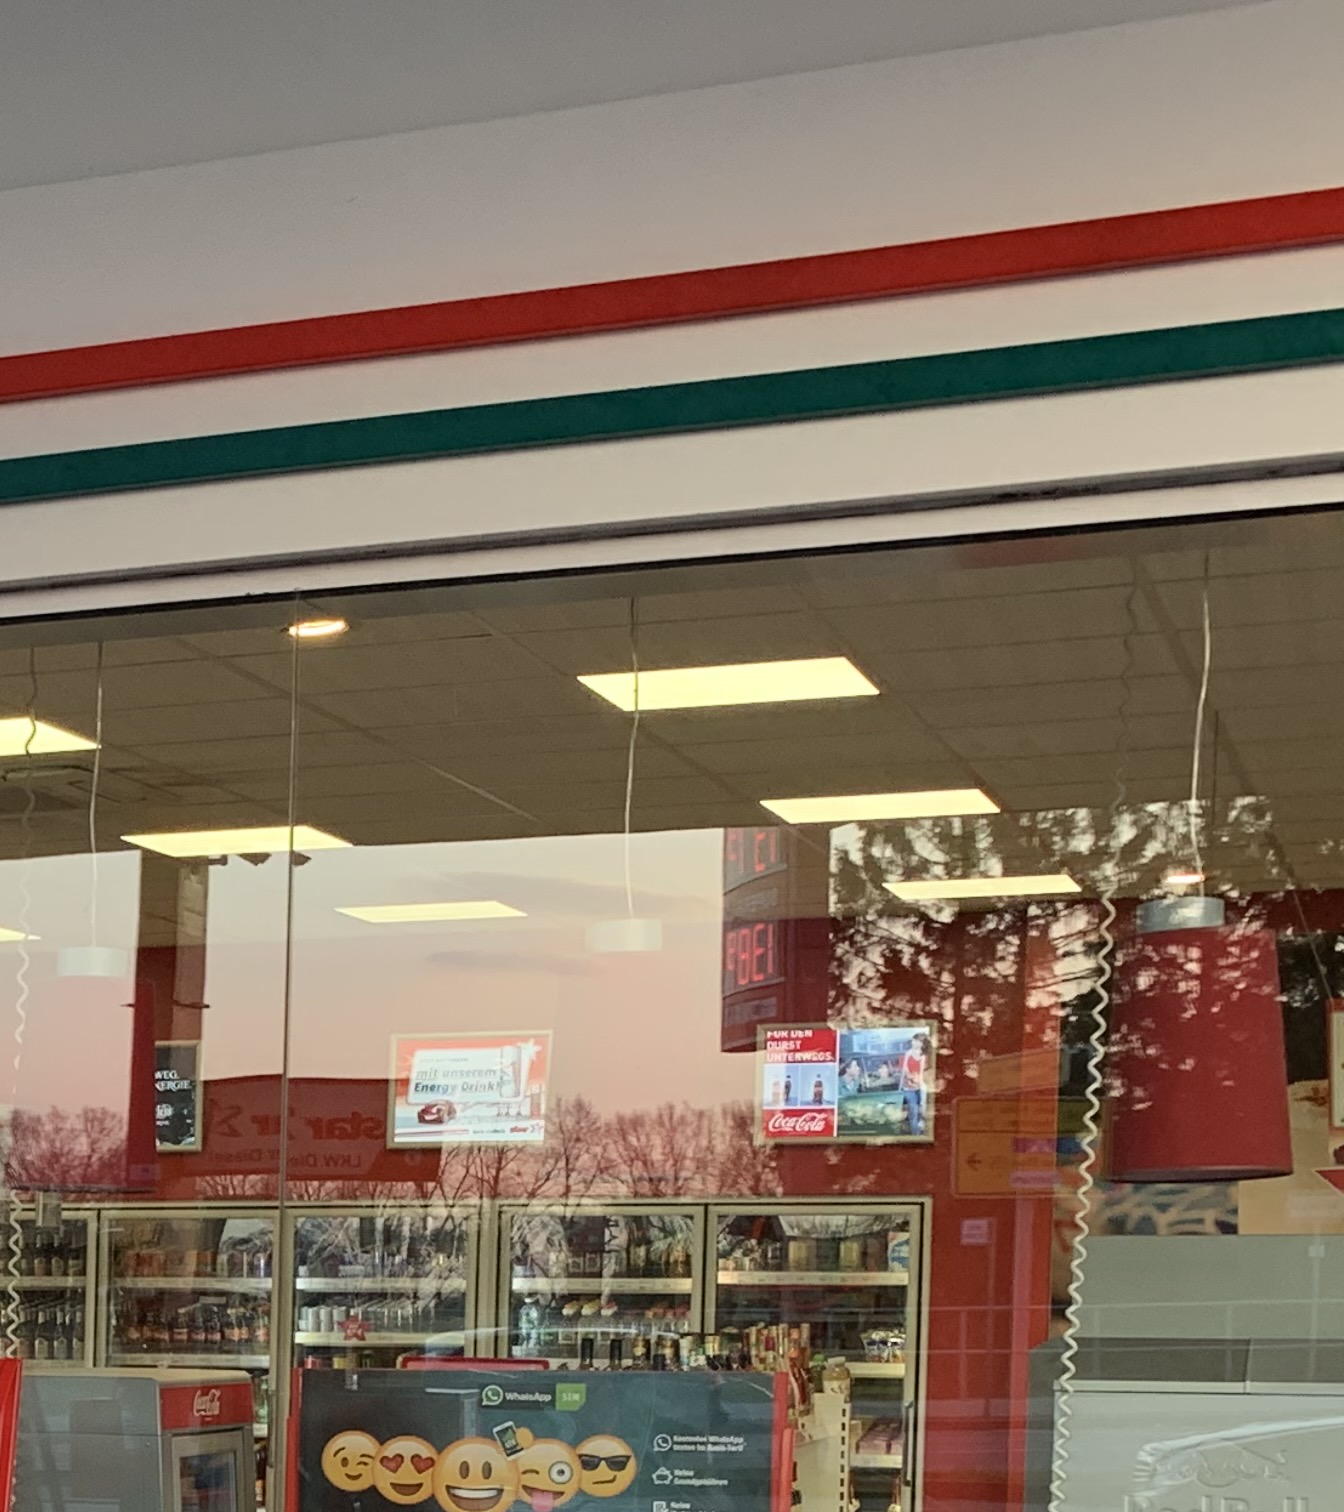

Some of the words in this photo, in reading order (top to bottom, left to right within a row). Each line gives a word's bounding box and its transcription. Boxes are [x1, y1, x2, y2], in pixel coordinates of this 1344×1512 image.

[766, 1040, 802, 1050] DURST
[415, 1068, 439, 1081] mit
[442, 1068, 497, 1079] unserem
[413, 1081, 458, 1096] Energy
[504, 1391, 552, 1403] WhatsApp
